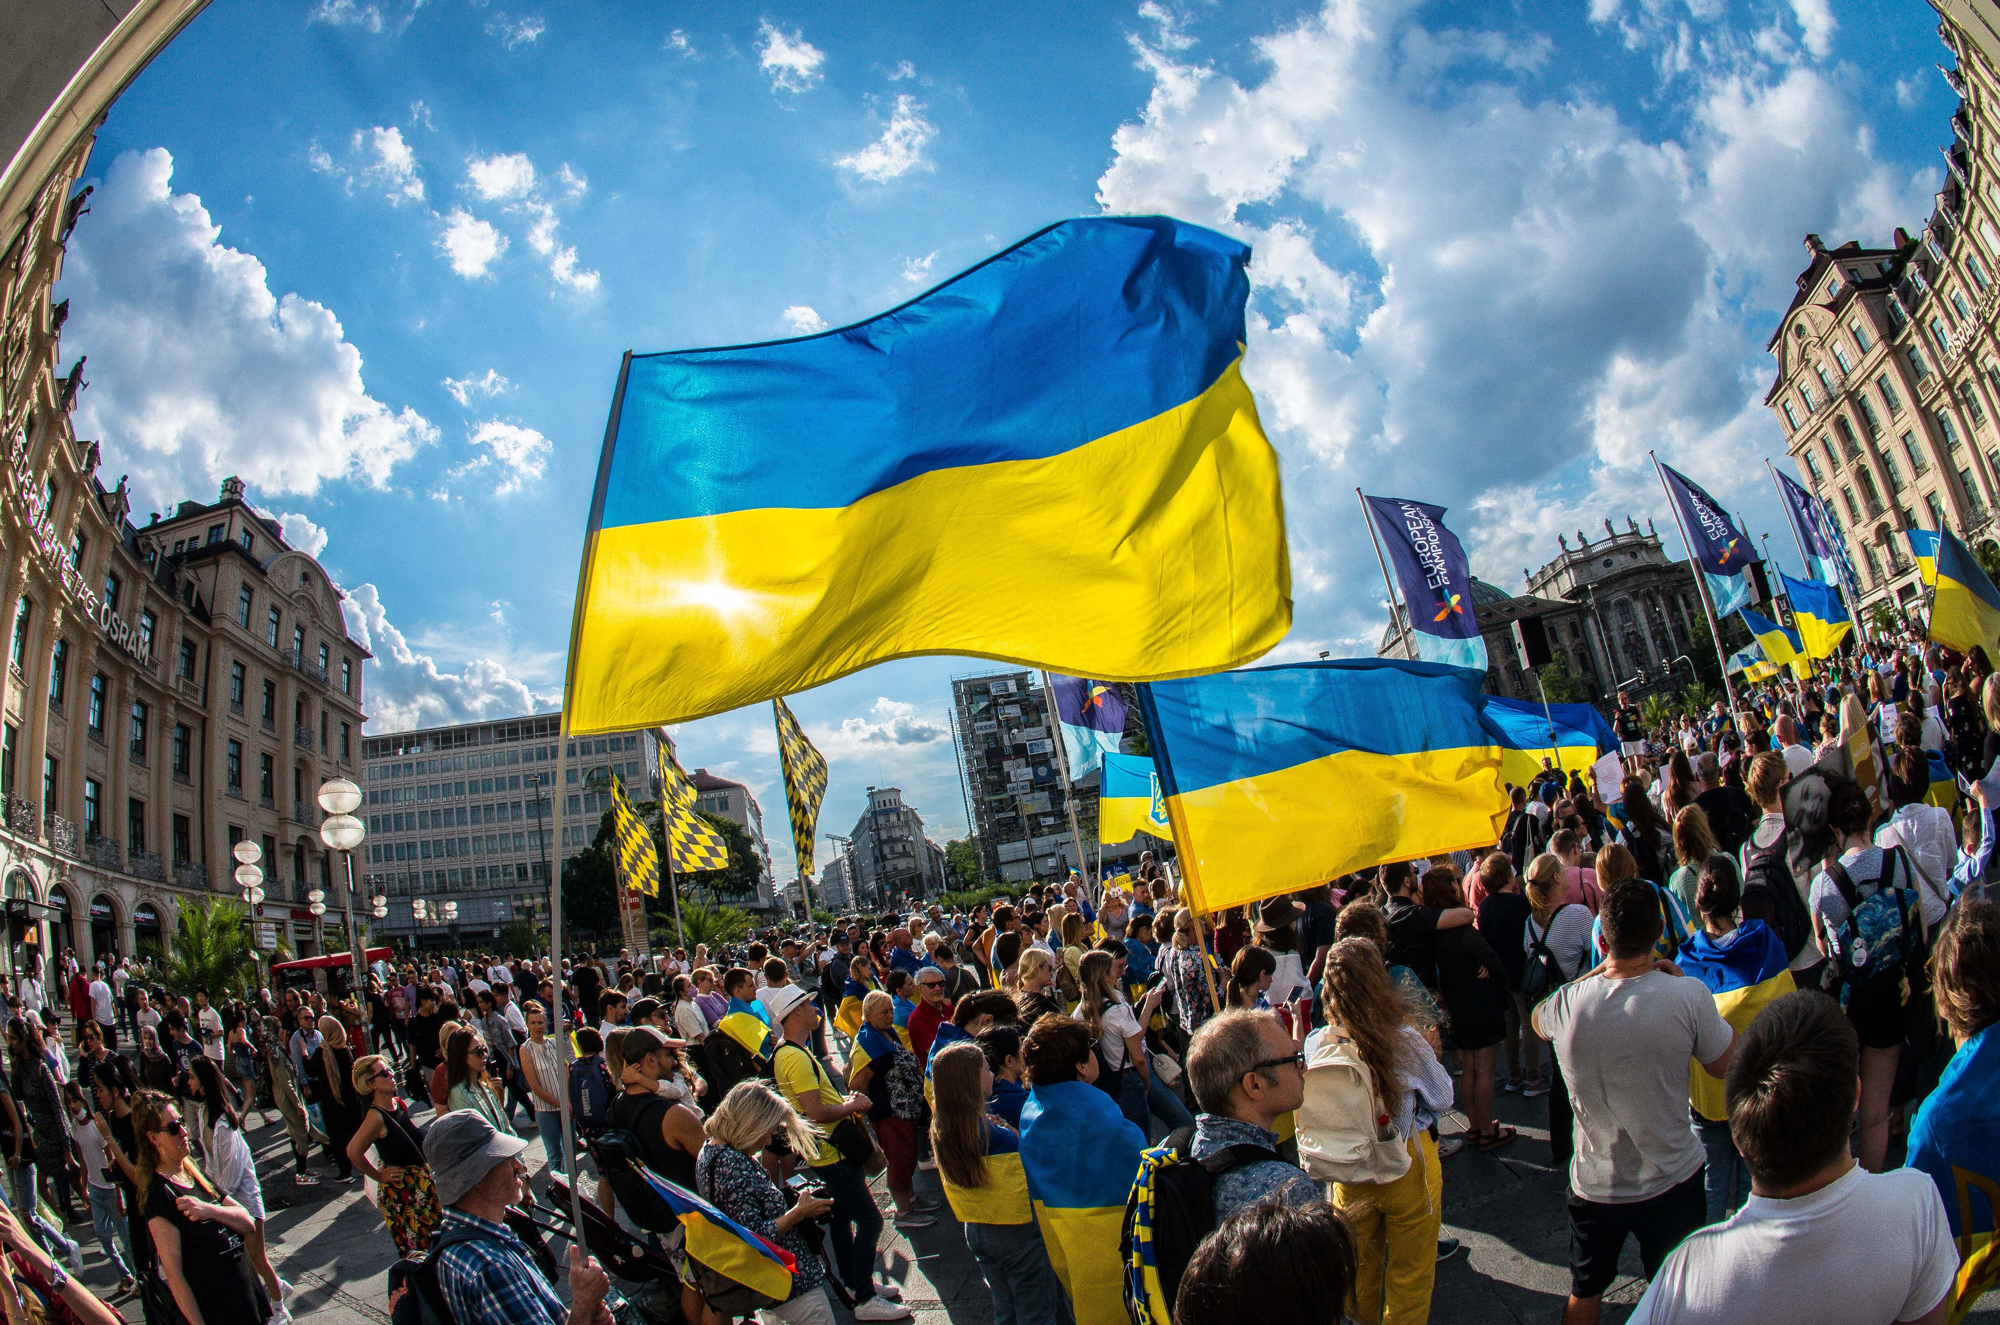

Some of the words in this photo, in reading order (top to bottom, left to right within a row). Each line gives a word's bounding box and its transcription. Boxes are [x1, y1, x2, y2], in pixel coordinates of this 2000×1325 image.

[1946, 307, 1980, 359] OSRAM
[1689, 490, 1720, 540] EUROPE
[1399, 502, 1442, 590] EUROPEAN
[101, 602, 151, 665] OSRAM
[1783, 613, 1792, 627] S
[621, 896, 640, 904] Tam
